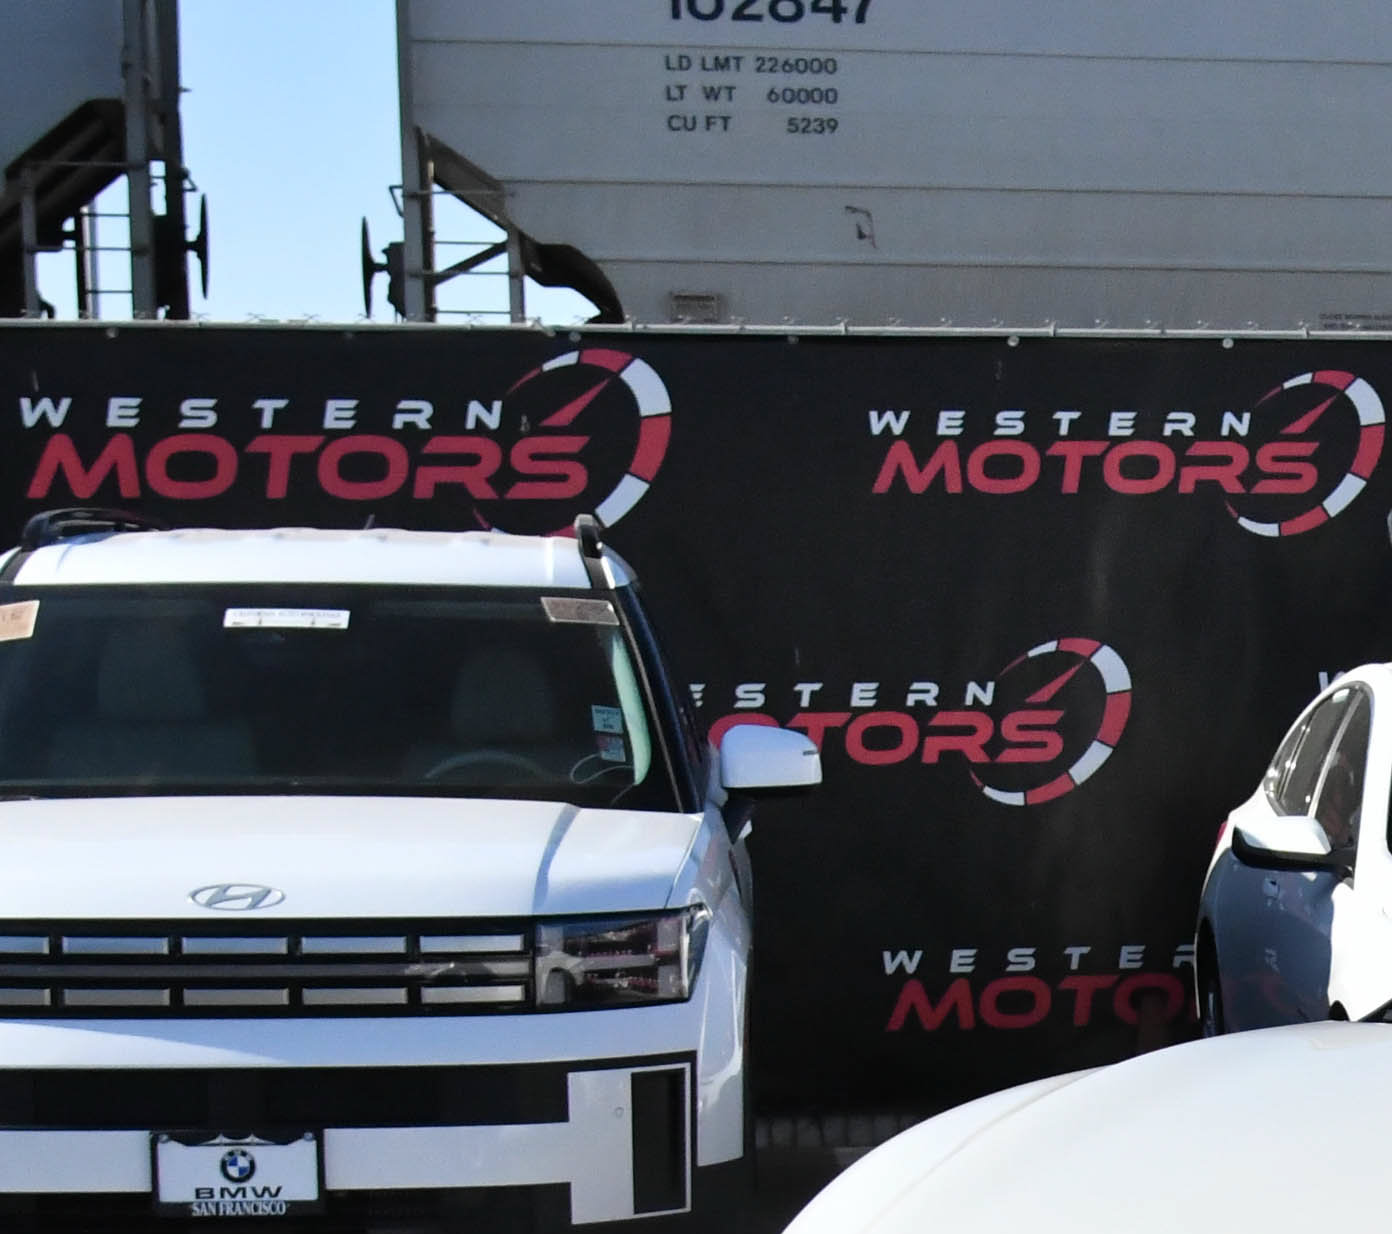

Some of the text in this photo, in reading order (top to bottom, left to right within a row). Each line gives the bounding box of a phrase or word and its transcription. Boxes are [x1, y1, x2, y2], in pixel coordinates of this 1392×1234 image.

[664, 55, 838, 74] LD LMT 226000
[665, 85, 839, 104] LT WT 60000
[667, 114, 839, 134] CU FT 5239
[20, 398, 502, 429] WESTERN
[869, 411, 1251, 436] WESTERN
[27, 435, 589, 500] MOTORS
[872, 440, 1319, 495] MOTORS
[195, 1186, 282, 1200] BMW
[192, 1201, 287, 1217] SAN FRANCISCO
